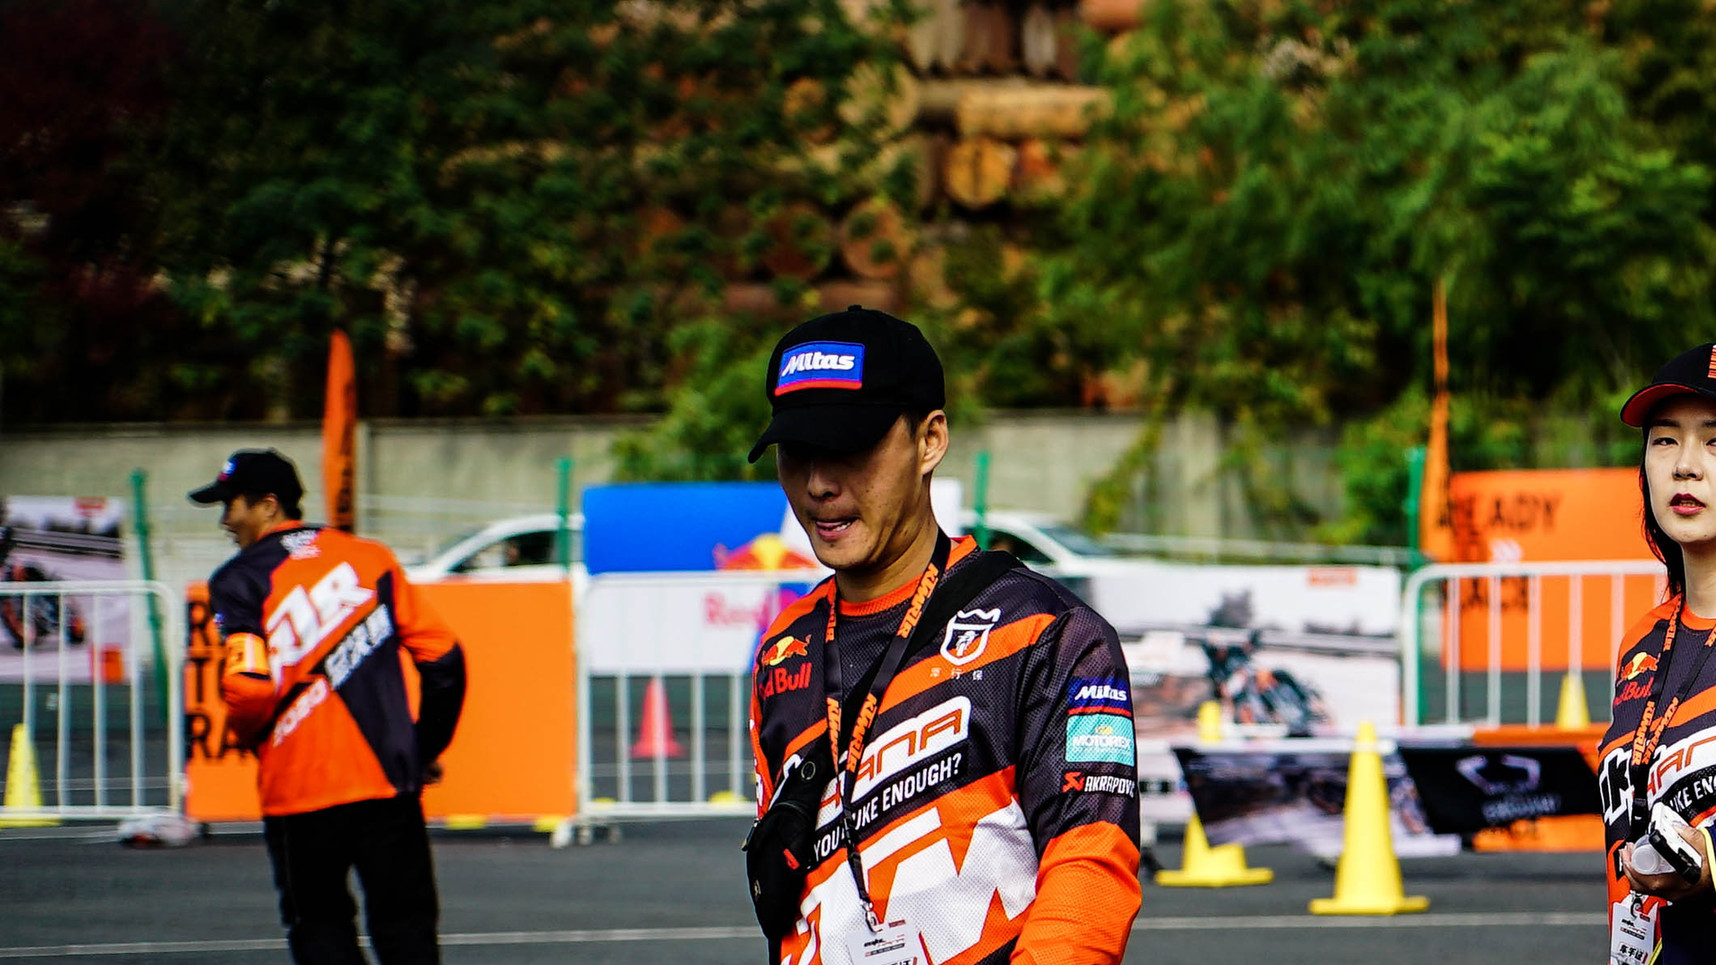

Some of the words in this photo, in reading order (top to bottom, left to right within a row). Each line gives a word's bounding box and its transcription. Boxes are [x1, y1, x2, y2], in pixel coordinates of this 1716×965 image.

[781, 352, 855, 377] Mitas
[774, 662, 812, 694] Bull
[1075, 685, 1128, 701] Mitas
[813, 831, 840, 861] YOU
[846, 801, 879, 834] UKE
[882, 752, 963, 812] ENOUGH?
